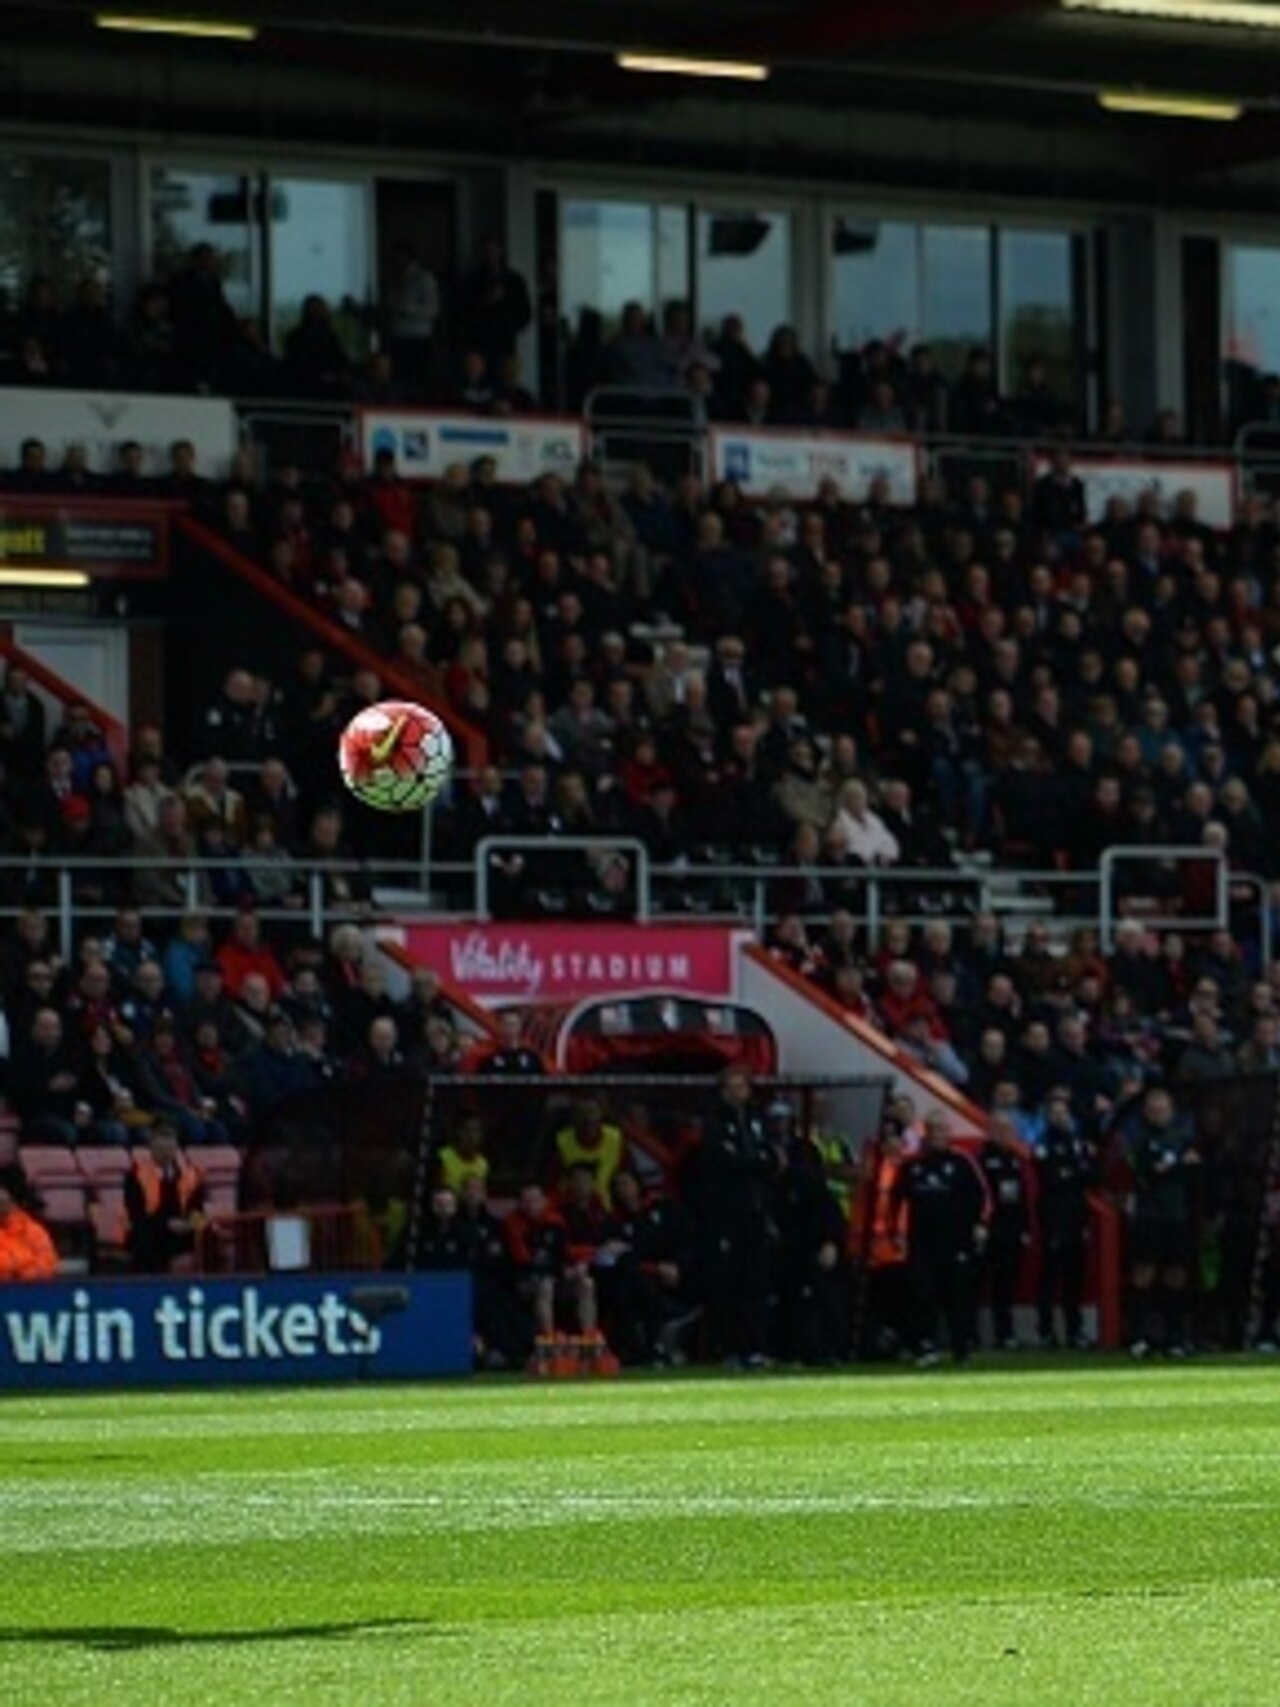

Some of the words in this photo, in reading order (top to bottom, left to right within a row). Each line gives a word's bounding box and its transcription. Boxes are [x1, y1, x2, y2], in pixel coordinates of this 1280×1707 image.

[450, 929, 544, 997] Vitality
[551, 953, 690, 980] STADIUM
[6, 1288, 135, 1363] win
[155, 1286, 382, 1360] tickets
